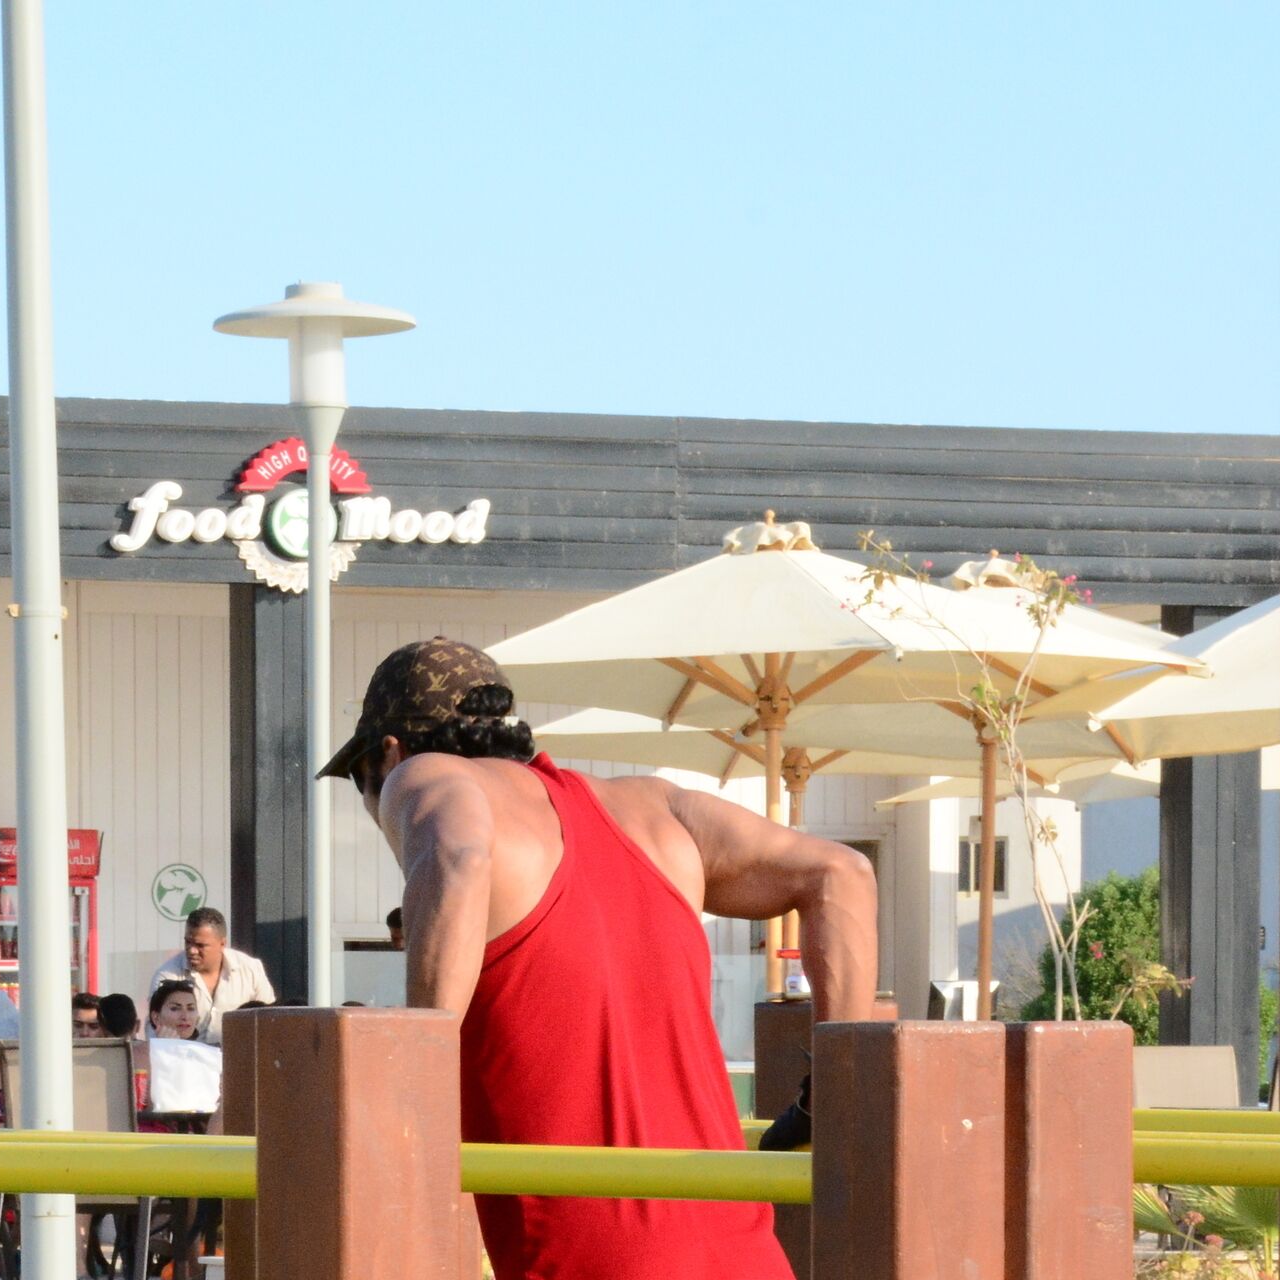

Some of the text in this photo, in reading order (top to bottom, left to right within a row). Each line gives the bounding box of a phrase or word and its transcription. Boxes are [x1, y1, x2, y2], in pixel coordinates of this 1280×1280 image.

[257, 445, 356, 480] HIGH QITY
[110, 480, 266, 552] food
